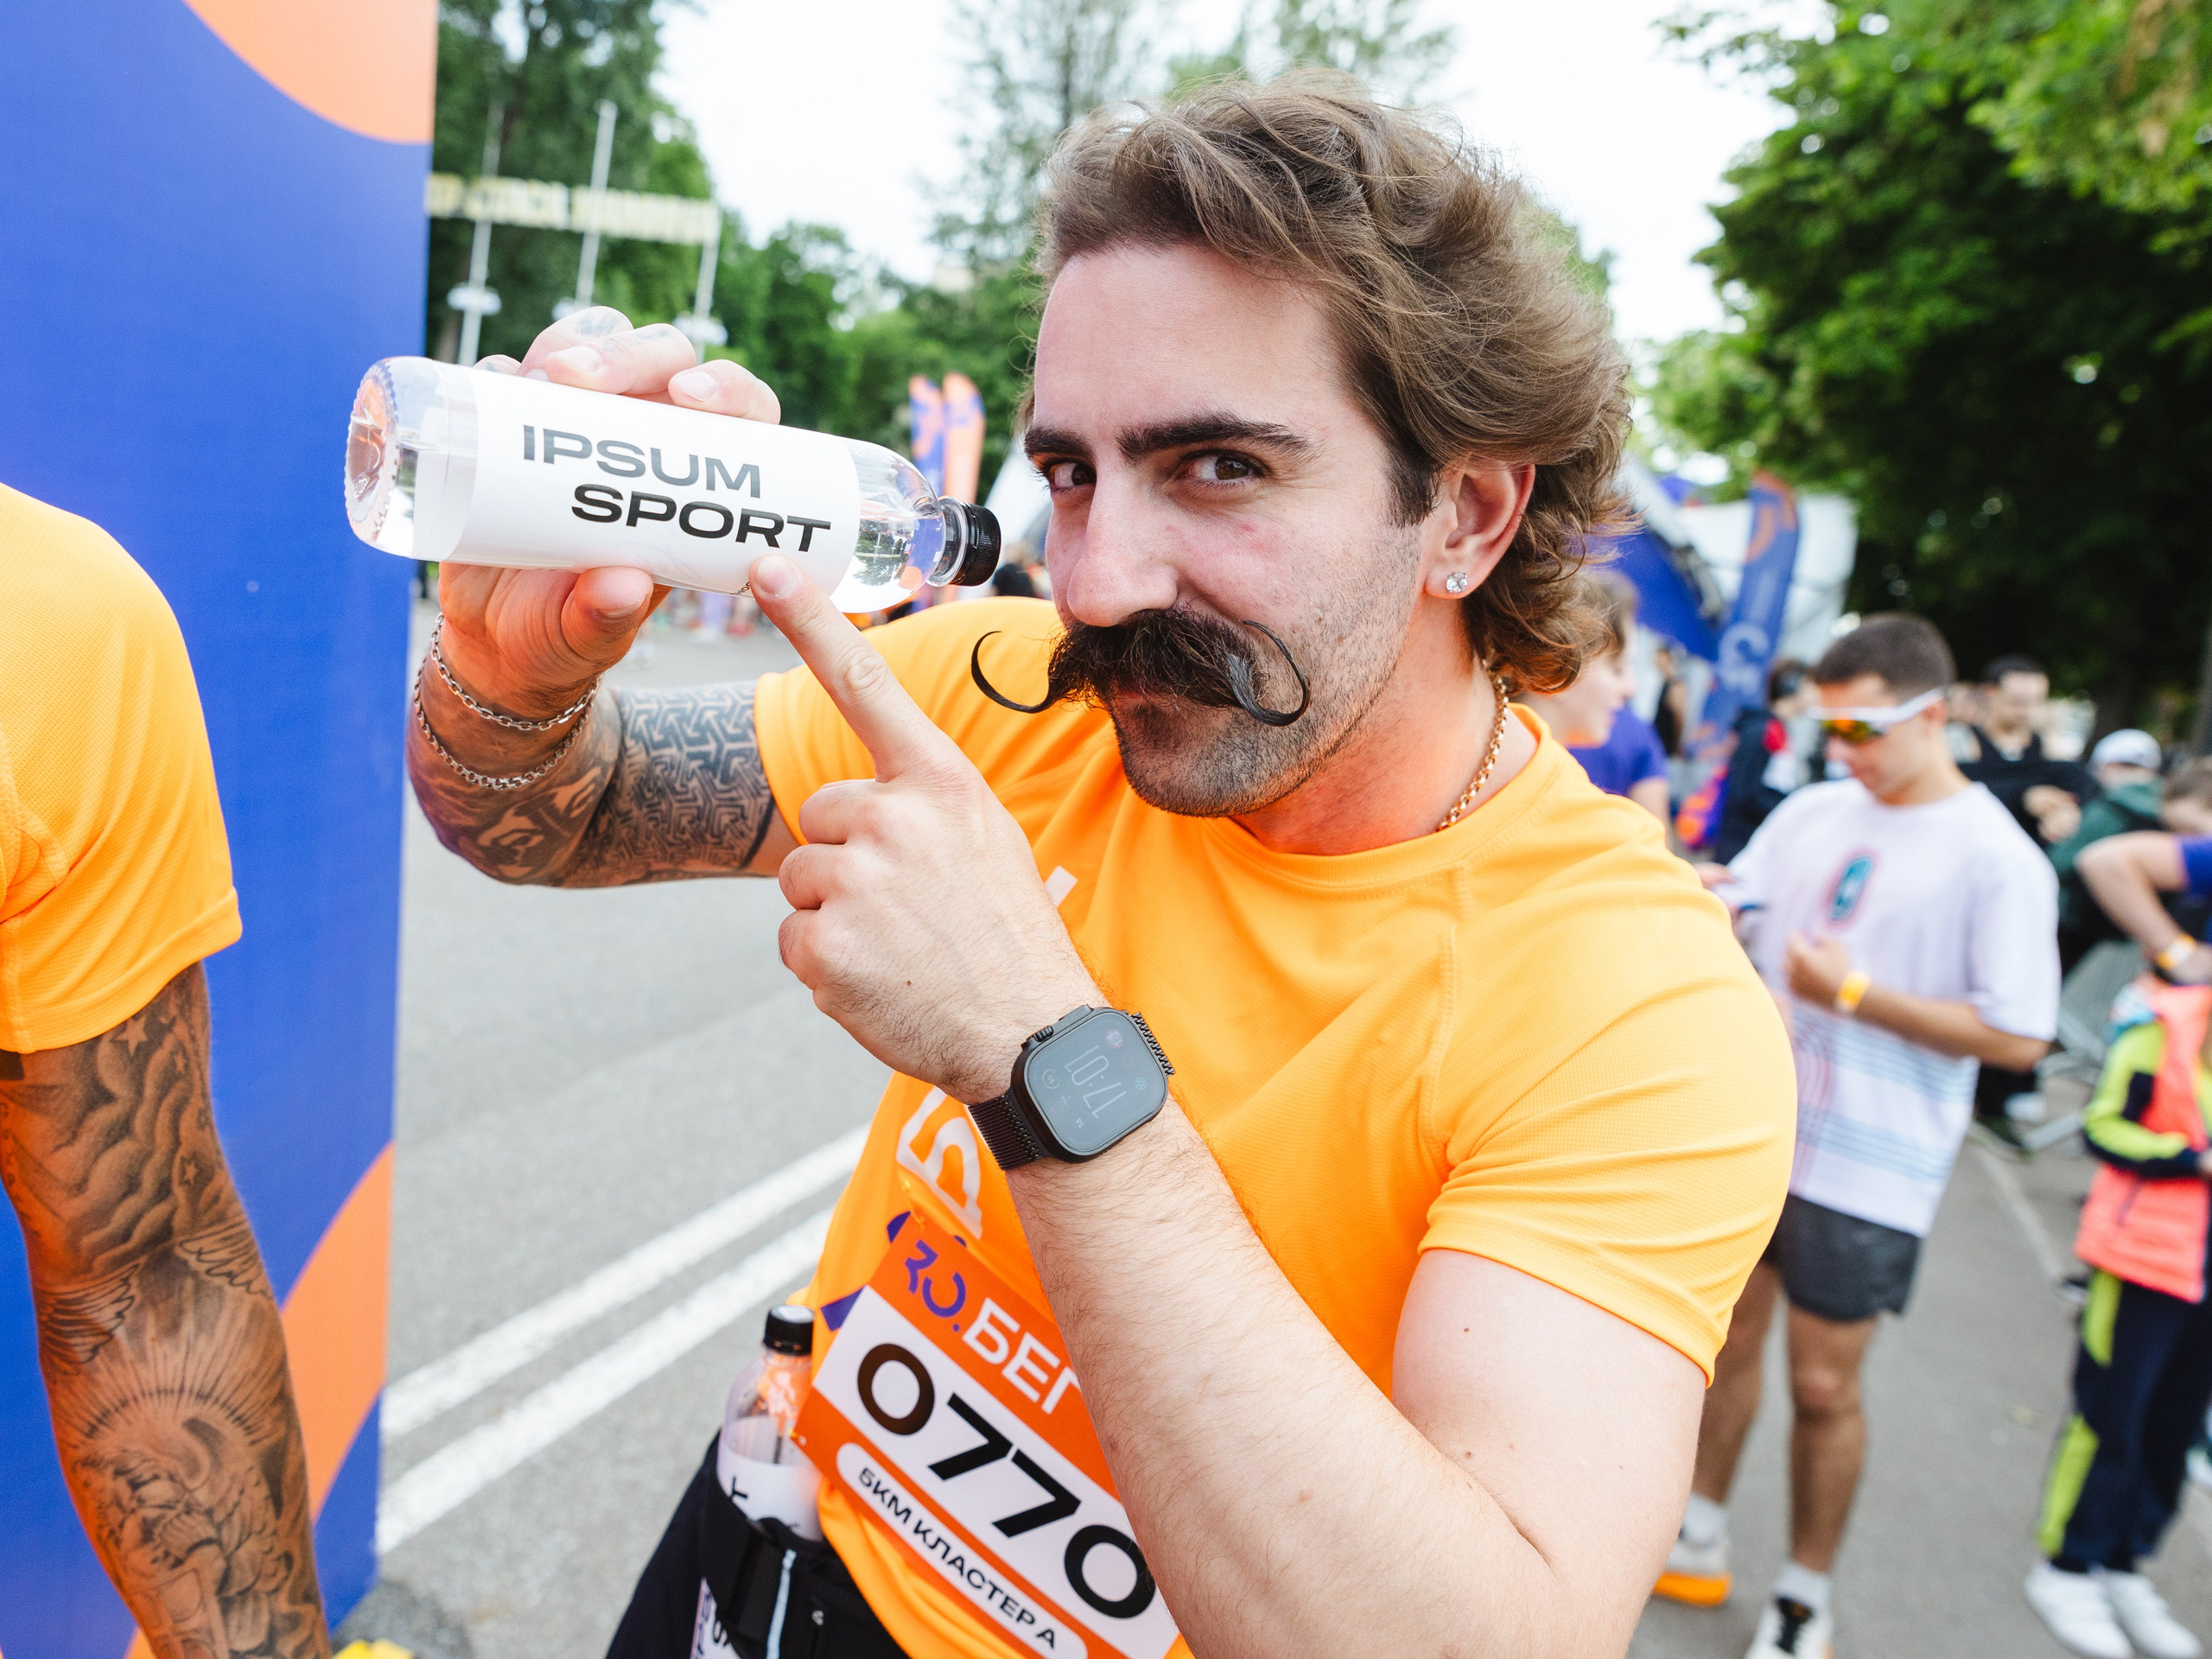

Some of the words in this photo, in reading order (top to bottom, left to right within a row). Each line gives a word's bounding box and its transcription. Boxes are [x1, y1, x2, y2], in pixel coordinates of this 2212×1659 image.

[522, 423, 761, 499] IPSUM
[570, 483, 832, 553] SPORT
[1064, 1044, 1128, 1119] 17:01
[856, 1343, 1157, 1620] 0770
[857, 1467, 912, 1525] 5КМ
[912, 1518, 1036, 1627] КЛАСТЕР
[1035, 1627, 1057, 1649] А
